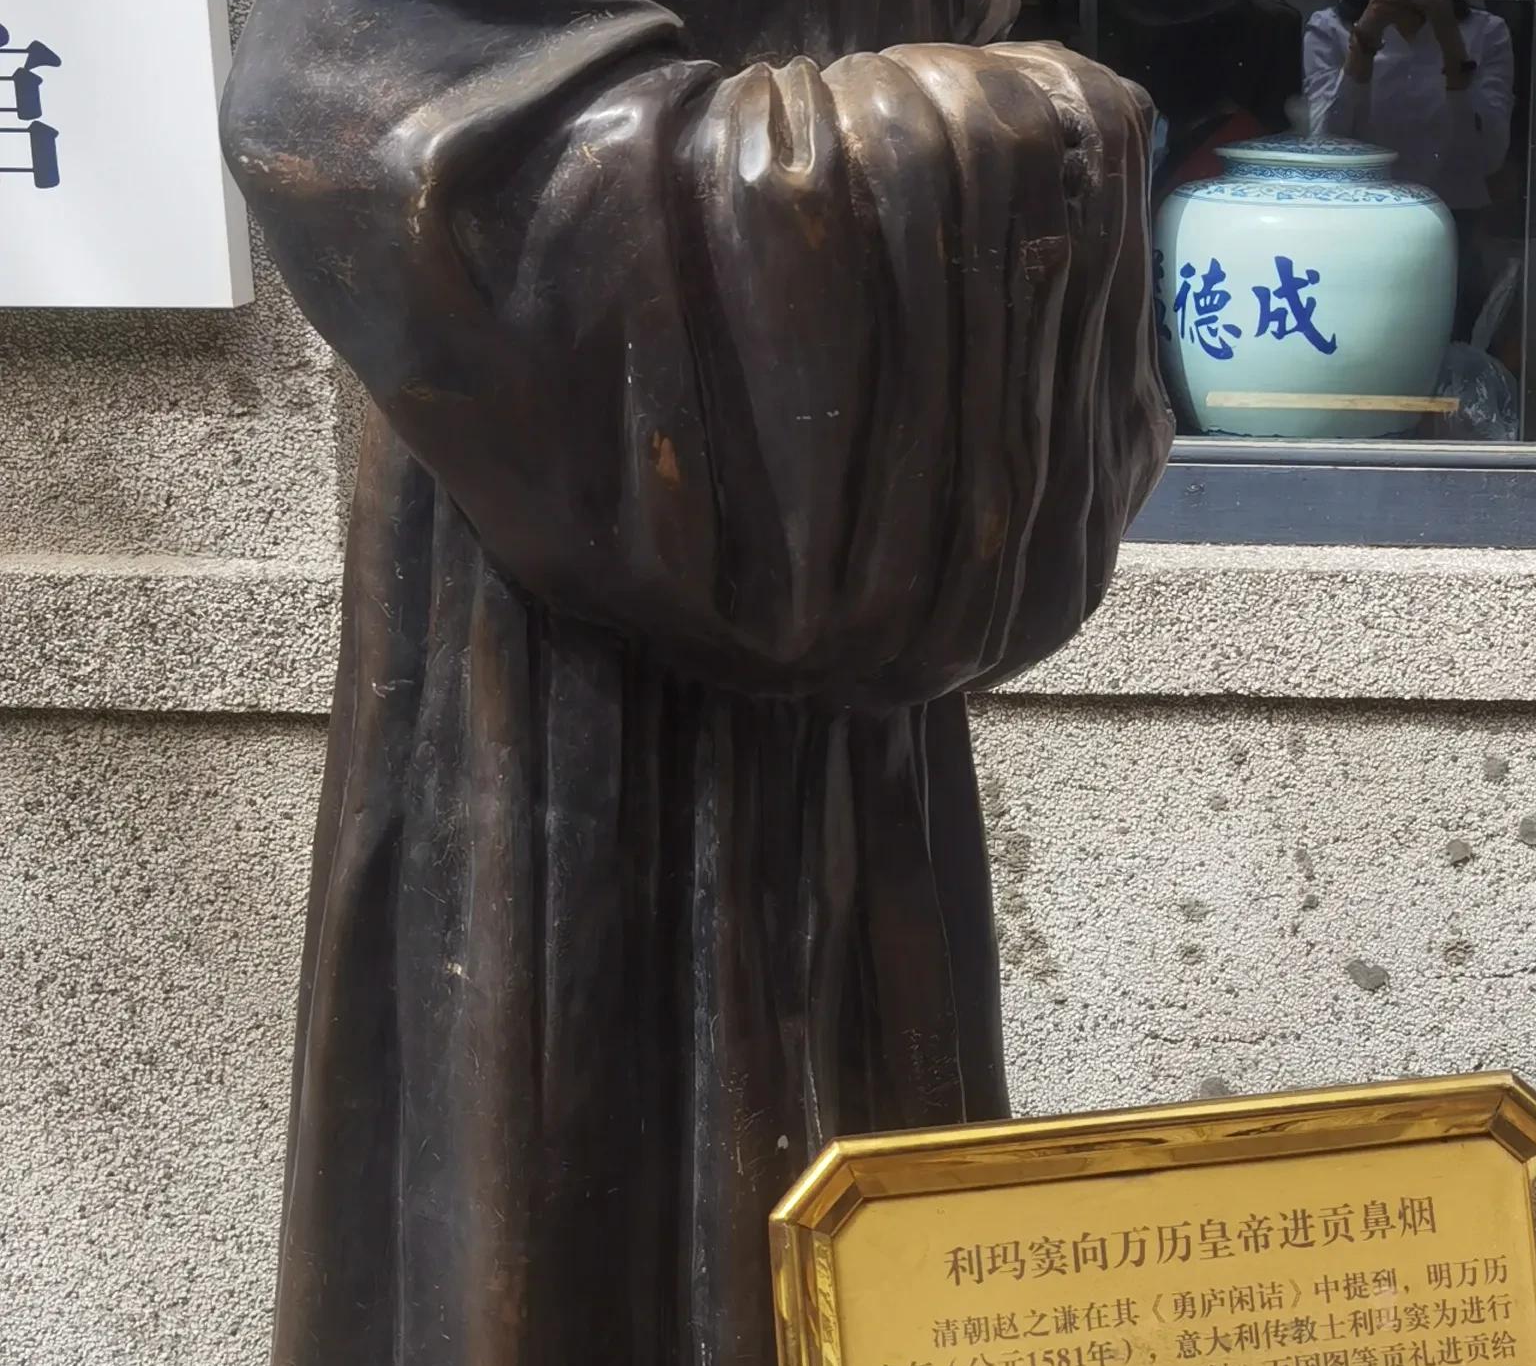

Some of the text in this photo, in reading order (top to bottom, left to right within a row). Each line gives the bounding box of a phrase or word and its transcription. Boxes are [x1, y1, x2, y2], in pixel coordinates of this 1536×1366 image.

[943, 1195, 1437, 1286] 利玛窦向万历皇帝进贡鼻烟
